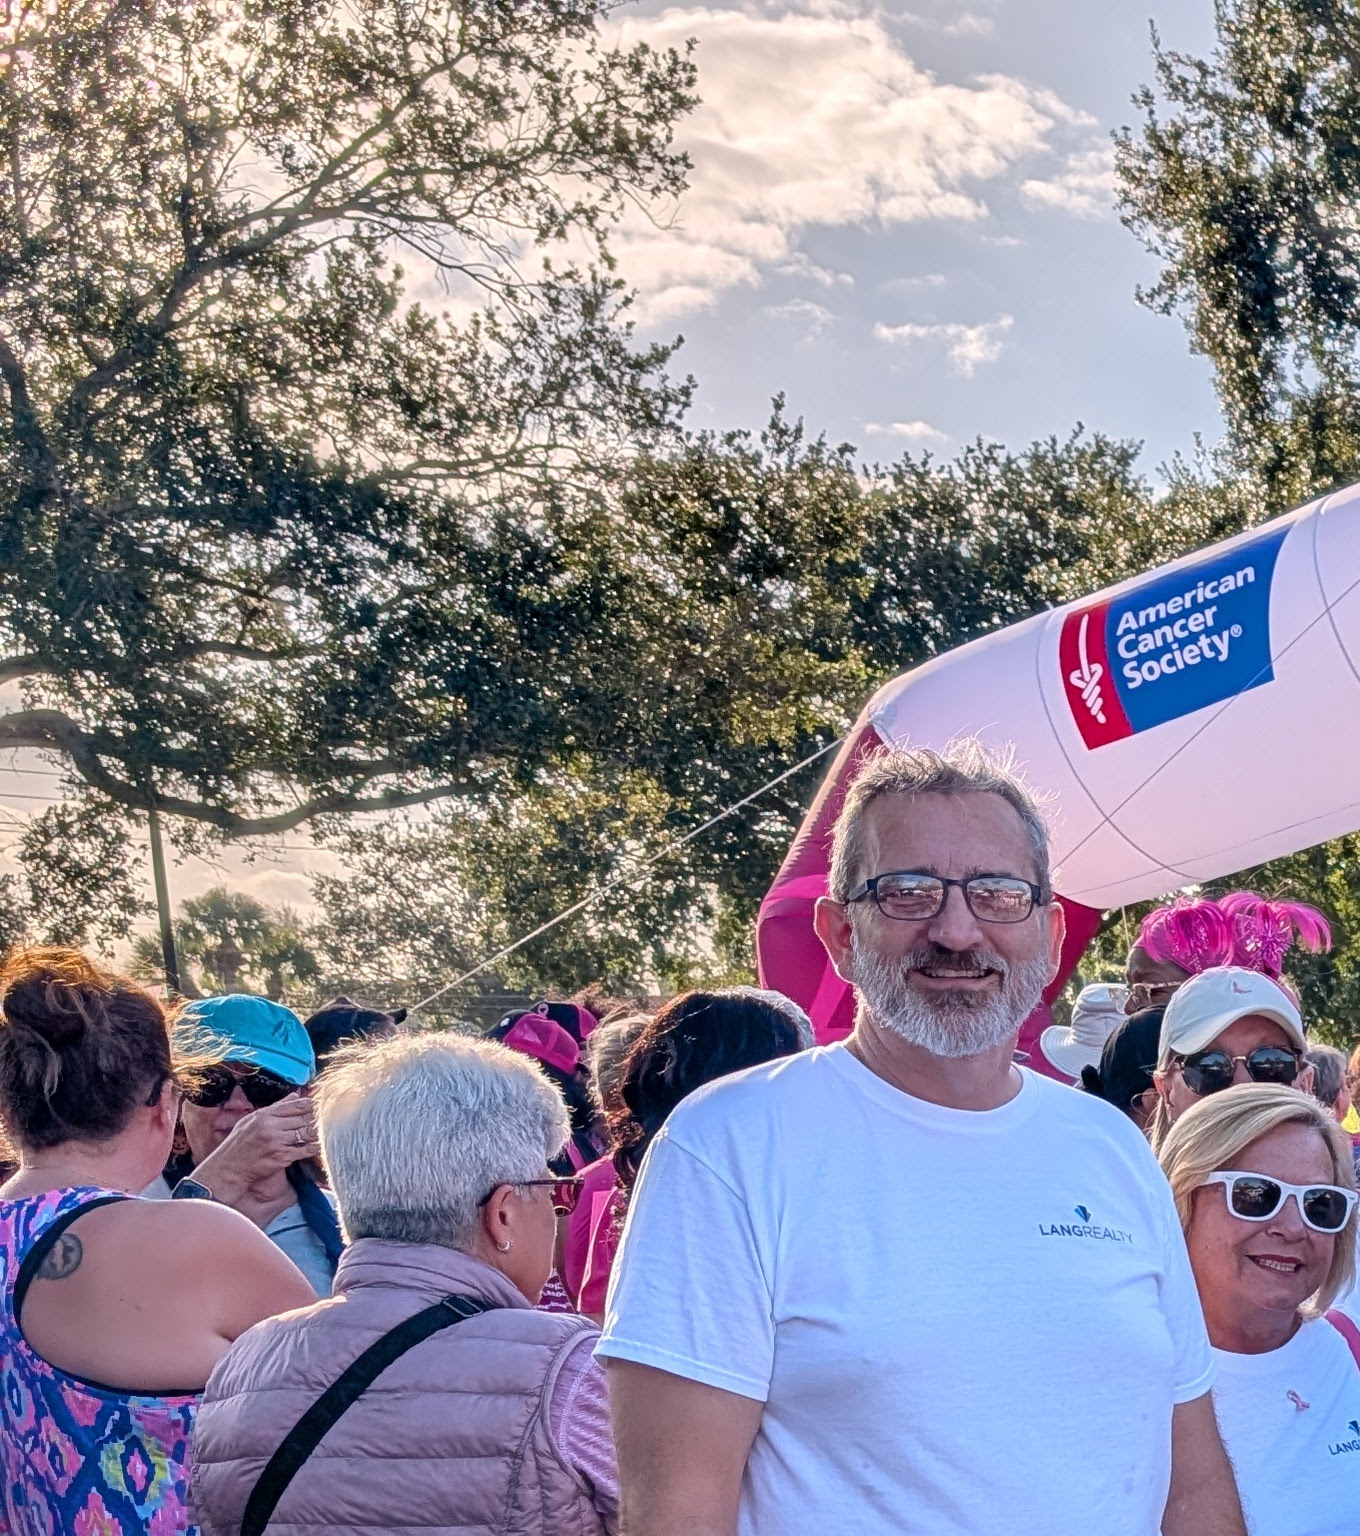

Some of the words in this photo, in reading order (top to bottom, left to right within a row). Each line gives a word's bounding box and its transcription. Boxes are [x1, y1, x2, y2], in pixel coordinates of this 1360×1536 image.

[1115, 565, 1256, 637] American
[1117, 604, 1218, 660] Cancer
[1038, 1223, 1134, 1244] LANGREALTY
